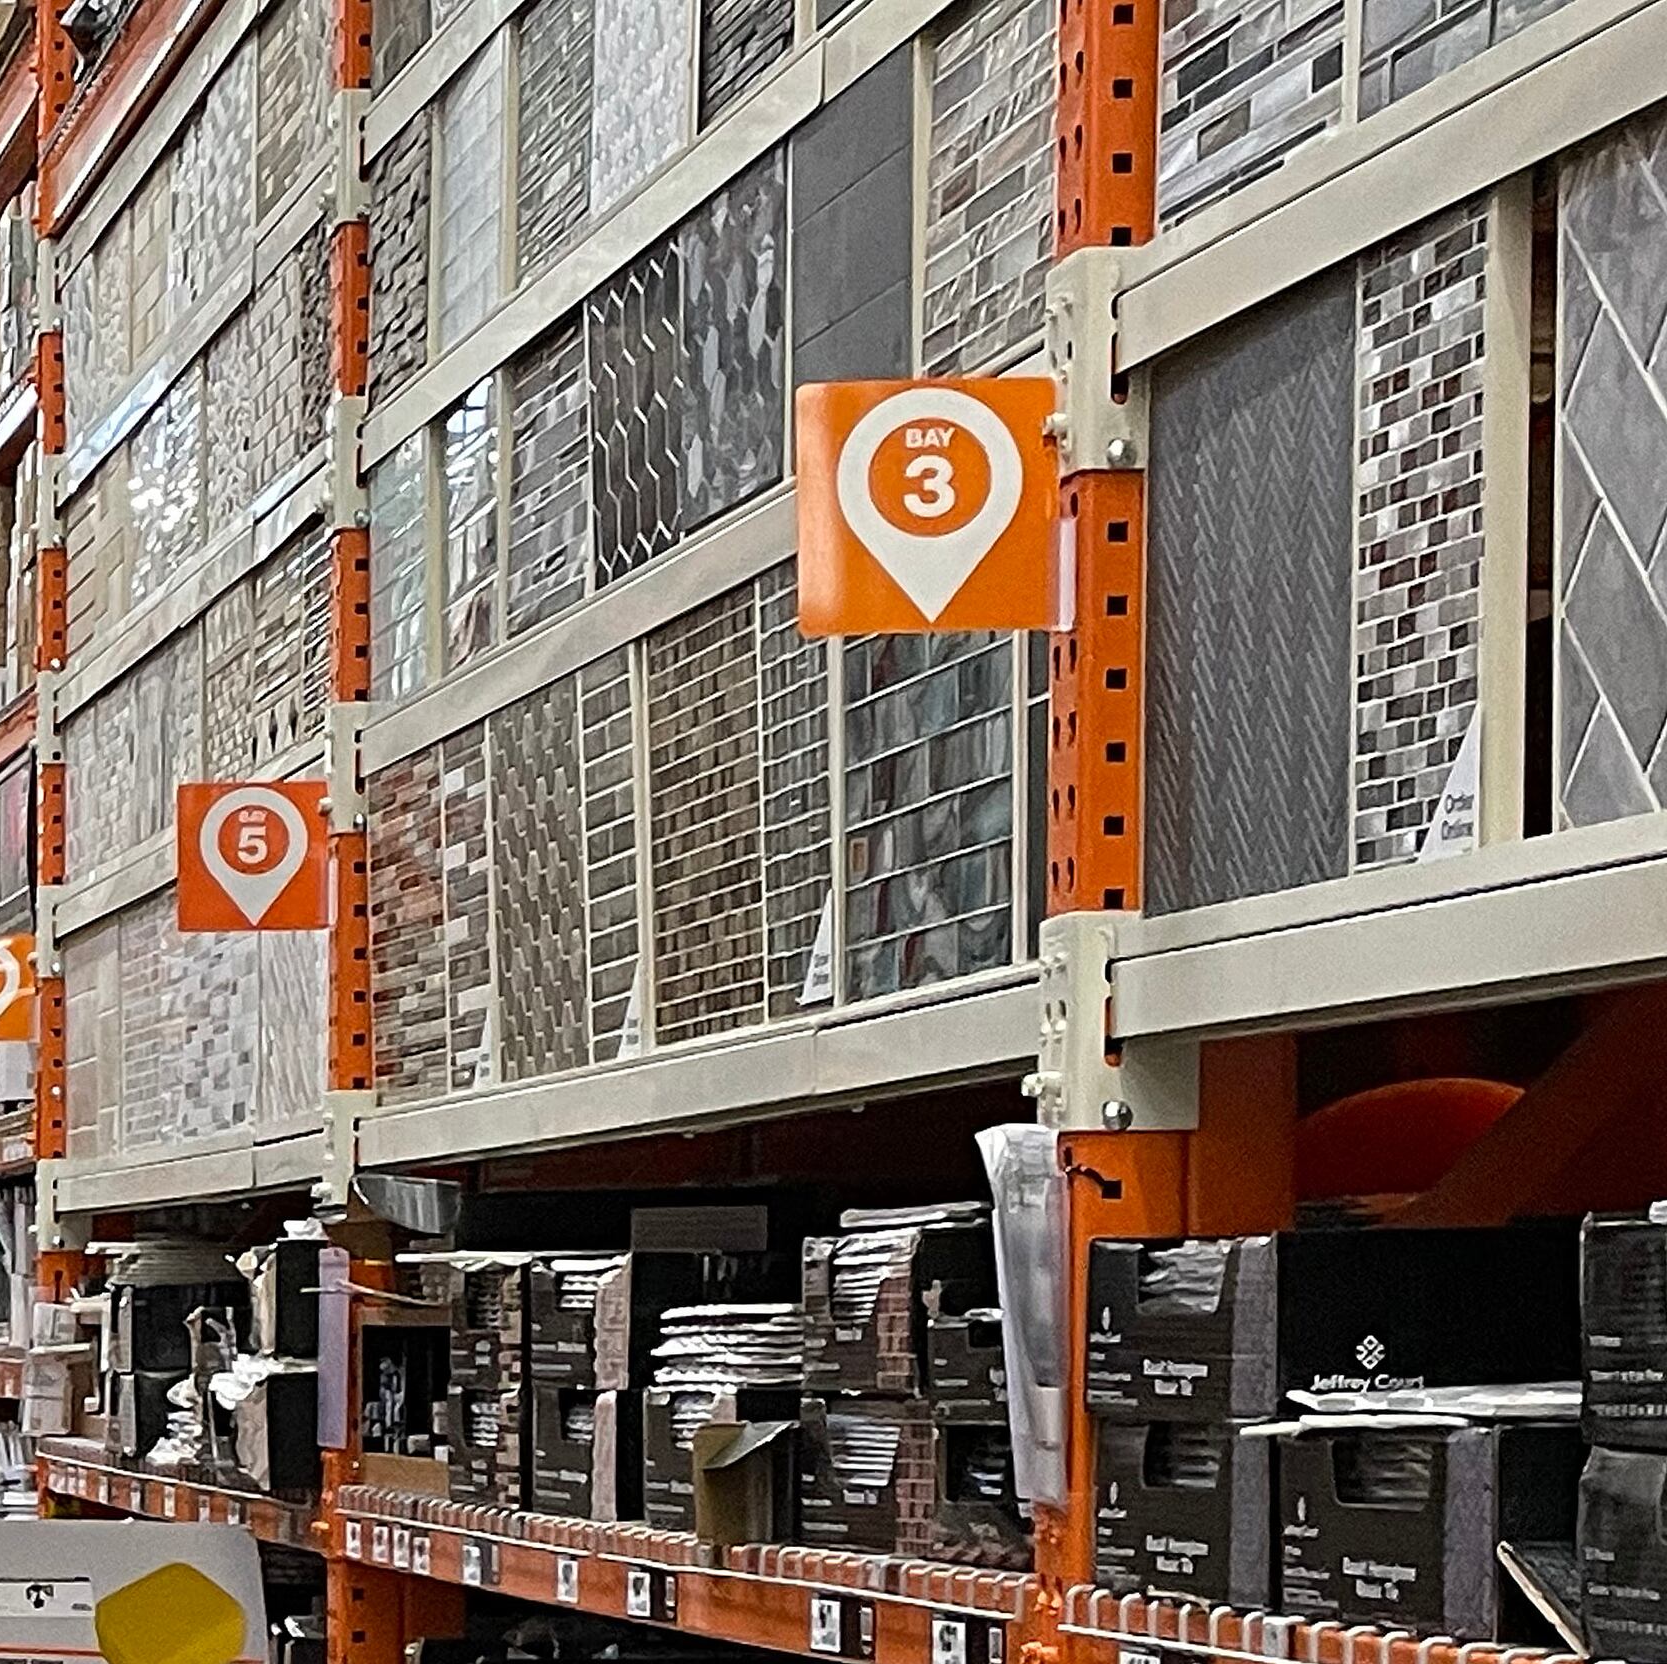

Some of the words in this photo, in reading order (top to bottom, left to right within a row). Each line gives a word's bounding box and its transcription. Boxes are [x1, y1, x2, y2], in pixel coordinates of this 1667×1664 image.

[905, 427, 956, 449] BAY
[903, 455, 957, 519] 3
[236, 825, 269, 865] 5
[1310, 1373, 1371, 1393] Jeffrey
[1374, 1374, 1425, 1390] Court
